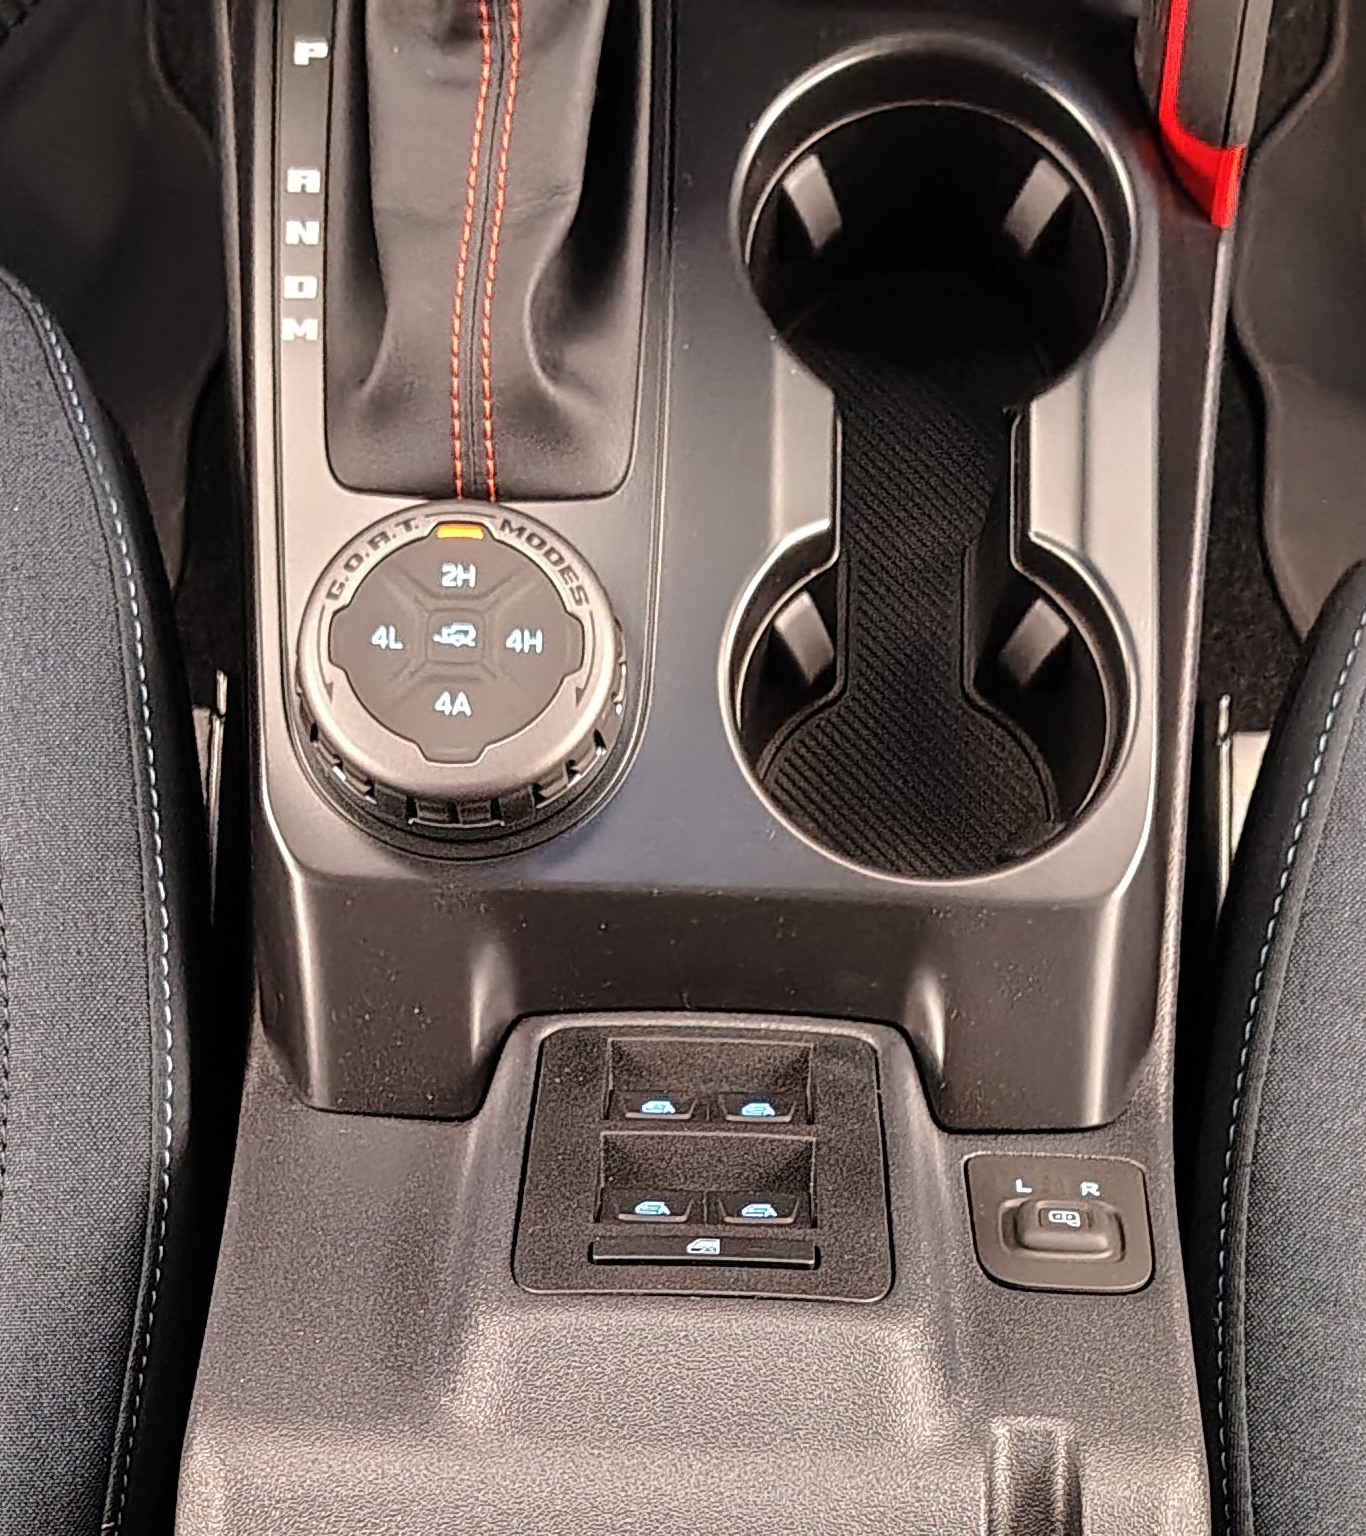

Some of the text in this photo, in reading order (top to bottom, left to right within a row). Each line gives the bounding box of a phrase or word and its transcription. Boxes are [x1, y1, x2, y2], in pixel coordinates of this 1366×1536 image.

[294, 40, 329, 66] P
[285, 220, 320, 246] N
[283, 274, 318, 300] D
[281, 317, 319, 342] M
[441, 562, 477, 588] 2H
[499, 518, 590, 608] MODES
[371, 625, 404, 650] 4L
[505, 628, 543, 654] 4H
[434, 690, 472, 717] 4A
[1015, 1178, 1101, 1197] L R
